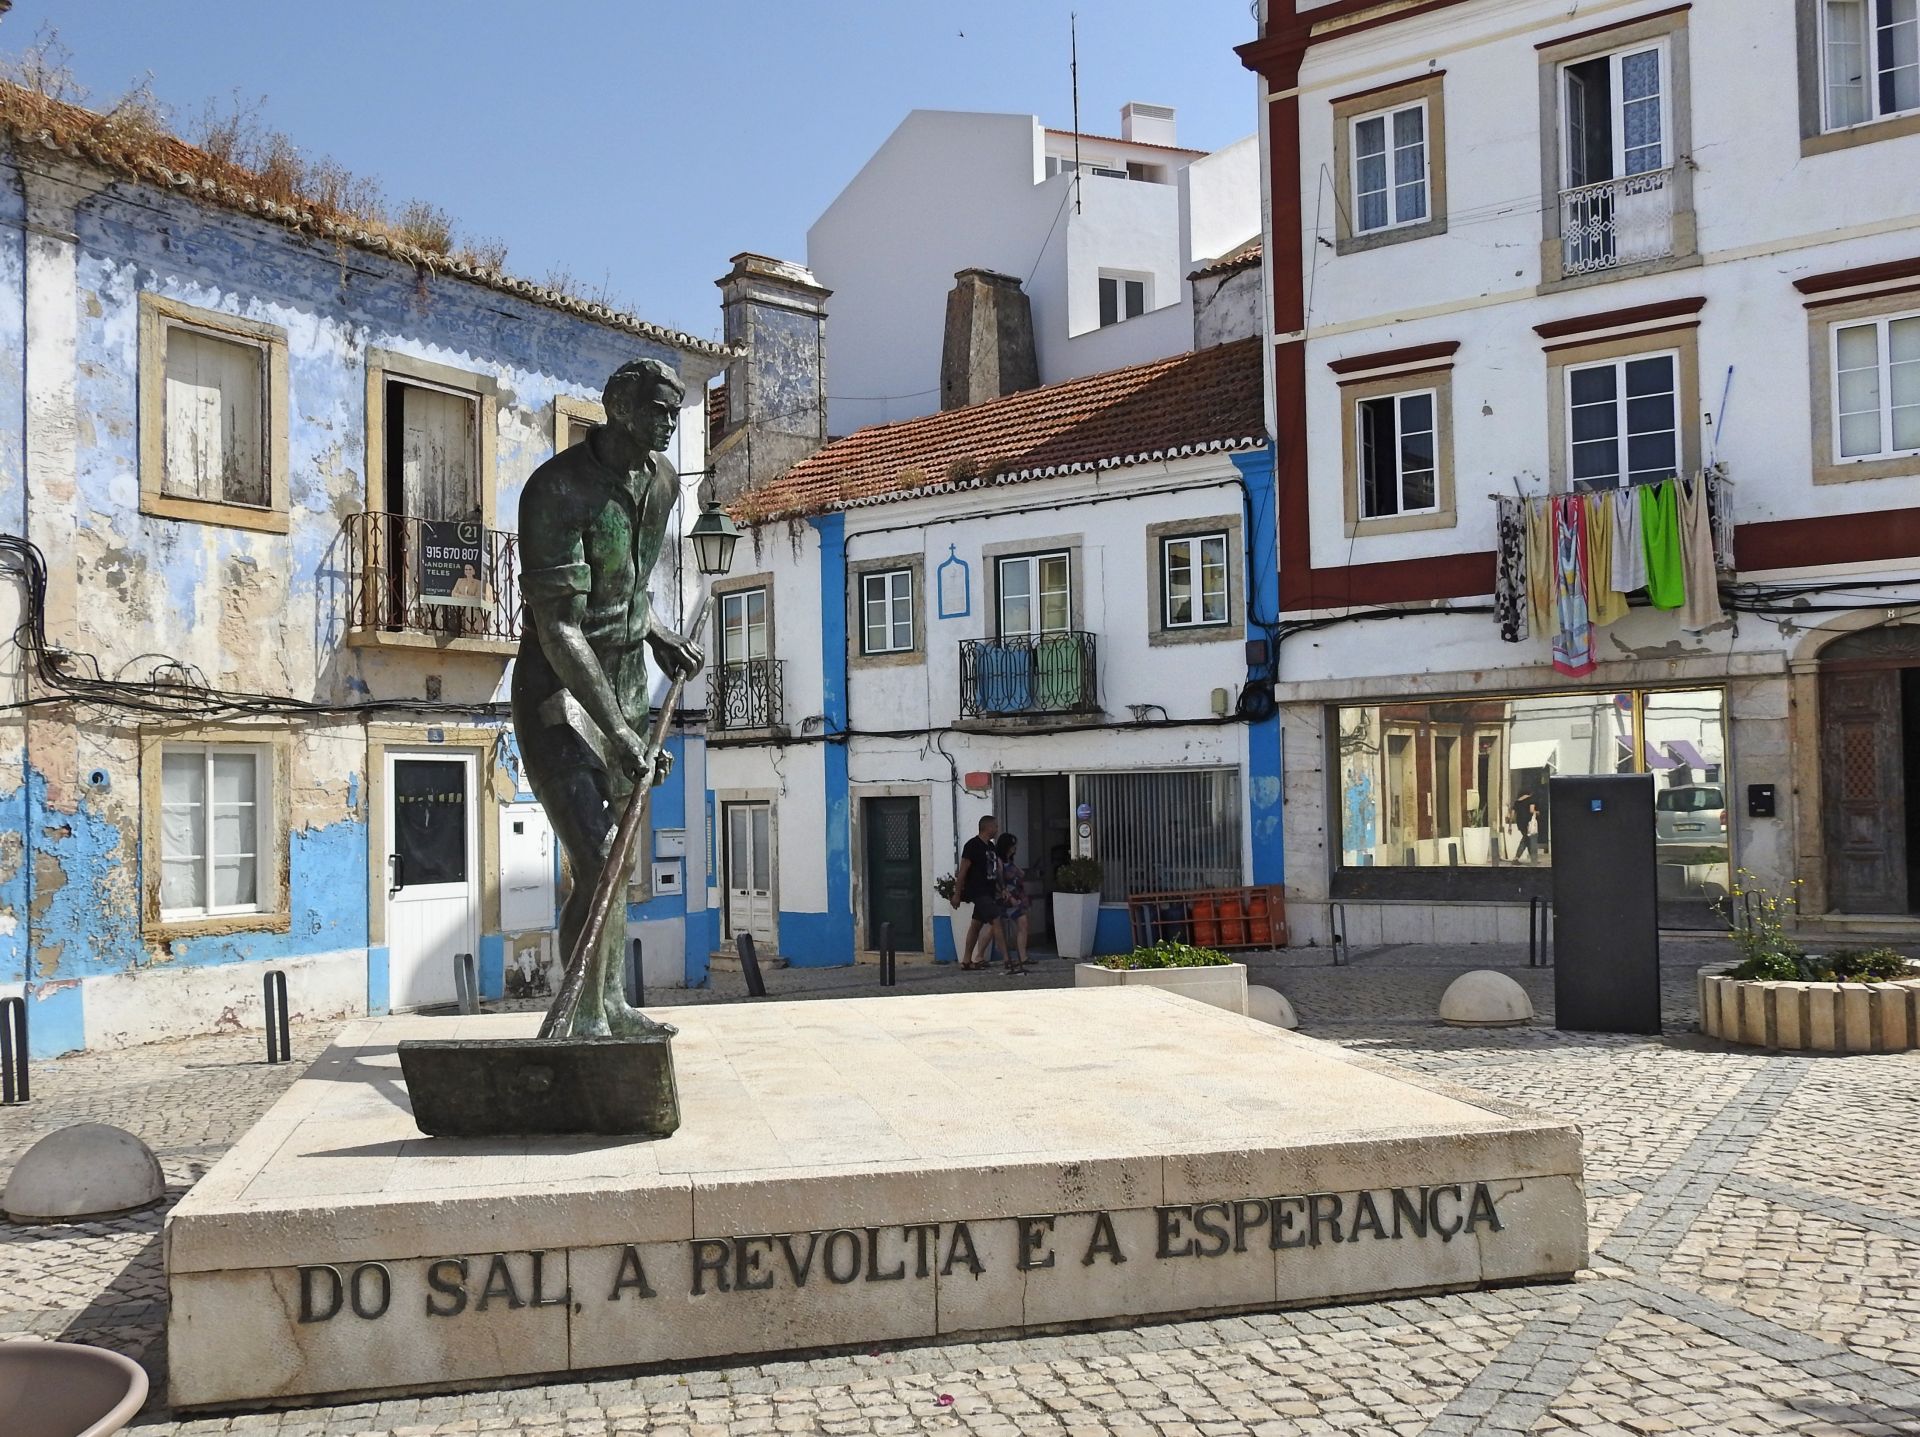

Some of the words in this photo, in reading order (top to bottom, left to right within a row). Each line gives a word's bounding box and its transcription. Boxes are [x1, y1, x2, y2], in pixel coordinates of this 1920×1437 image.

[426, 545, 442, 559] 915
[443, 547, 460, 560] 670
[461, 548, 479, 561] 807
[427, 561, 461, 569] ANDREIA
[427, 569, 450, 577] TELES
[1887, 609, 1896, 619] 8
[297, 1261, 392, 1323] DO
[426, 1249, 582, 1317] SAL,
[608, 1243, 657, 1301] A
[689, 1220, 986, 1296] REVOLTA
[1015, 1213, 1056, 1270] E
[1081, 1209, 1127, 1265] A
[1155, 1181, 1505, 1259] ESPERANÇA
